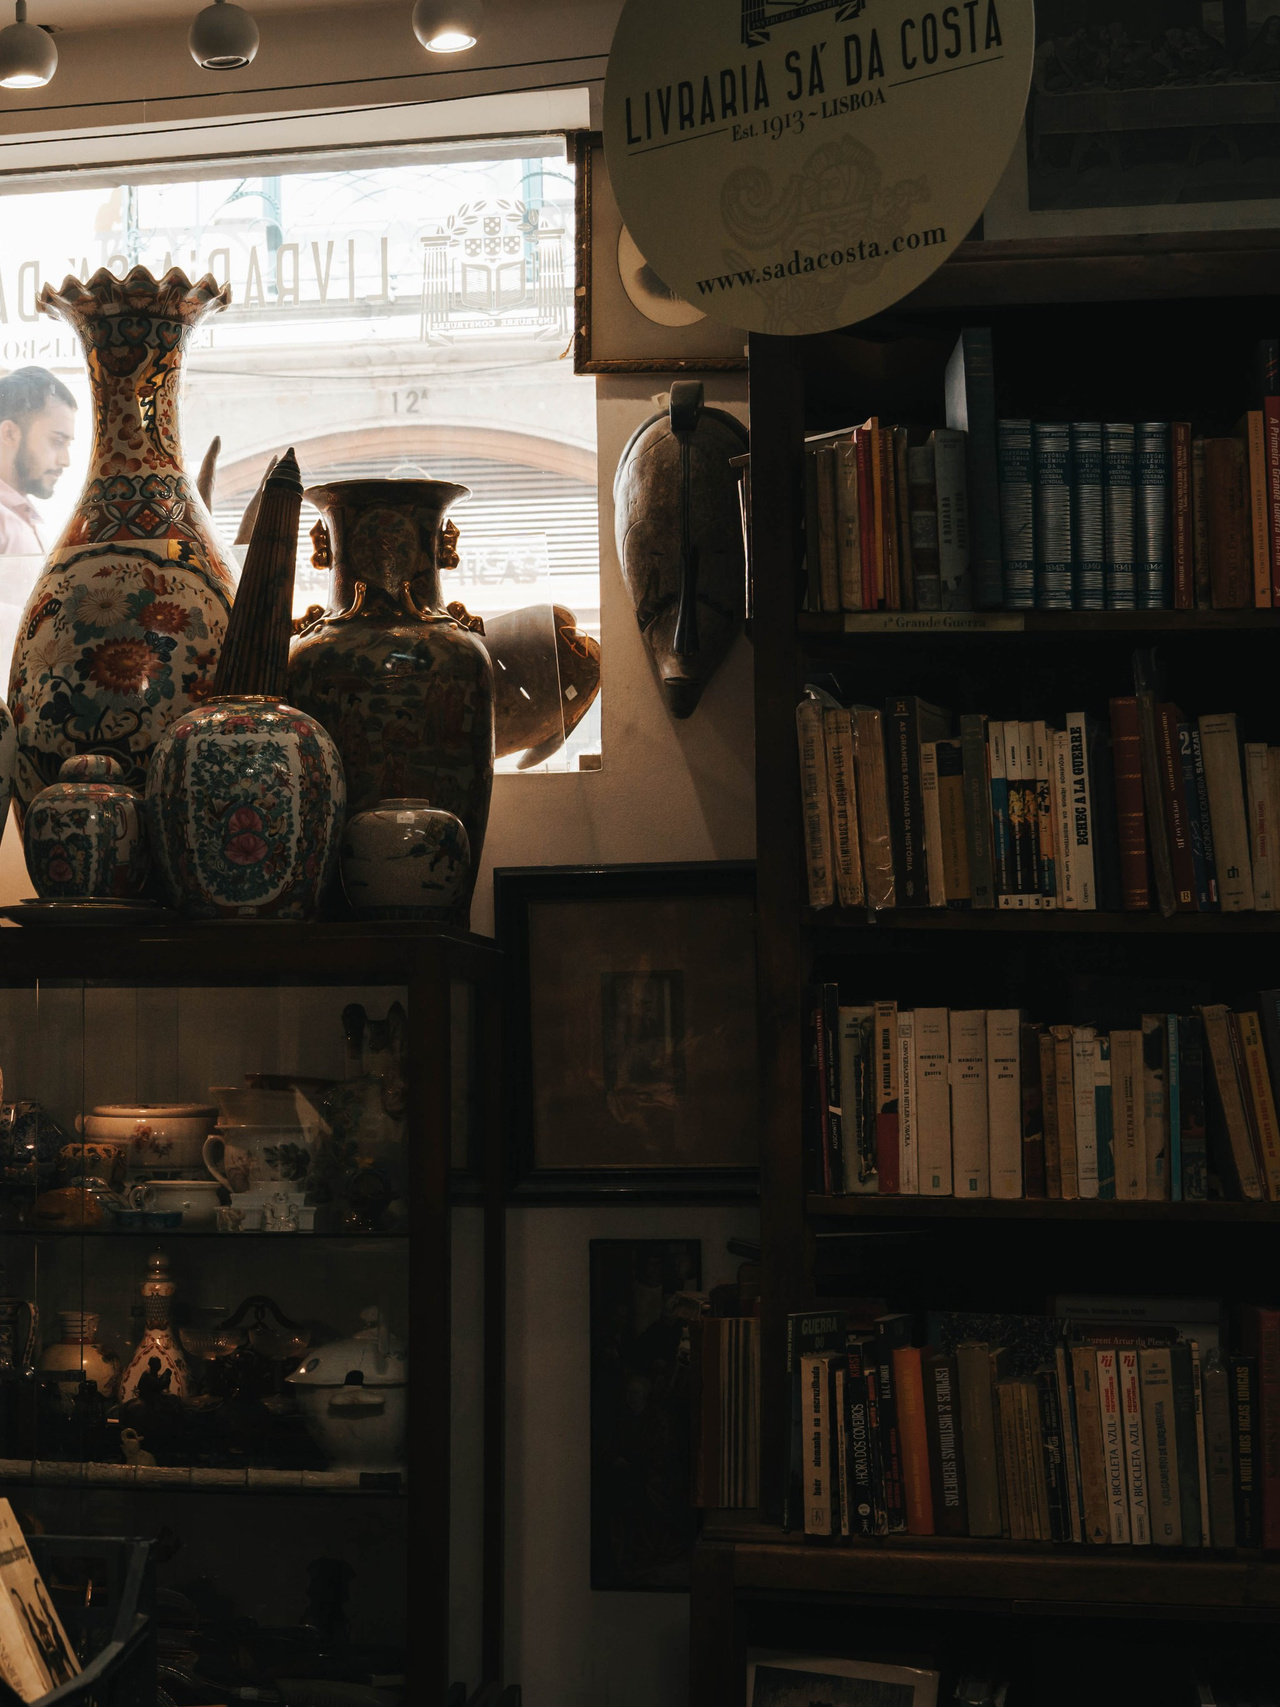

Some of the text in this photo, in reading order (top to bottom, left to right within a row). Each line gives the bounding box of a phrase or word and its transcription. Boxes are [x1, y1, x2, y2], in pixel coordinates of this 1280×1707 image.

[626, 59, 770, 145] LIVRARIA
[845, 27, 885, 86] DA
[900, 0, 1004, 71] COSTA
[731, 86, 886, 143] Est. 1913 LISBOA
[695, 224, 948, 297] www.sadacosta.com
[1270, 427, 1280, 466] Primeira
[1272, 467, 1280, 500] Grande
[896, 616, 986, 628] Grande Guerra
[1161, 712, 1172, 755] CHRISTOPHER
[832, 744, 843, 769] LESTE
[899, 721, 914, 871] AS GRANDES BATALHAS DA HISTÓRIA
[1070, 726, 1089, 846] ECHEC A LA GUERRE
[1191, 730, 1214, 861] ANTÓNIO DE OLIVEIRA SALAZAR
[839, 822, 852, 875] PRELIMINARES
[1003, 898, 1010, 906] 4
[1034, 898, 1040, 906] 3
[1045, 899, 1051, 907] 2
[882, 1052, 891, 1060] DE
[902, 1040, 910, 1087] CONVERSAZIONI
[882, 1063, 891, 1089] BATALHA
[831, 1118, 839, 1149] AUSCHWITZ
[802, 1317, 838, 1335] GUERRA
[1113, 1337, 1134, 1345] Artur
[848, 1353, 860, 1378] KIRST
[879, 1365, 890, 1383] PARKER
[1236, 1366, 1249, 1401] LONGAS
[811, 1366, 821, 1468] alemanha na encruzilhada
[851, 1403, 868, 1480] HORA DOS COVEIROS
[934, 1367, 960, 1507] ESPIÕES HISTÓRIAS SECRETAS
[1239, 1434, 1251, 1454] DOS
[1106, 1420, 1123, 1507] A BICICLETA AZUL
[1128, 1420, 1144, 1508] A BICICLETA AZUL
[1240, 1458, 1252, 1483] NOITE
